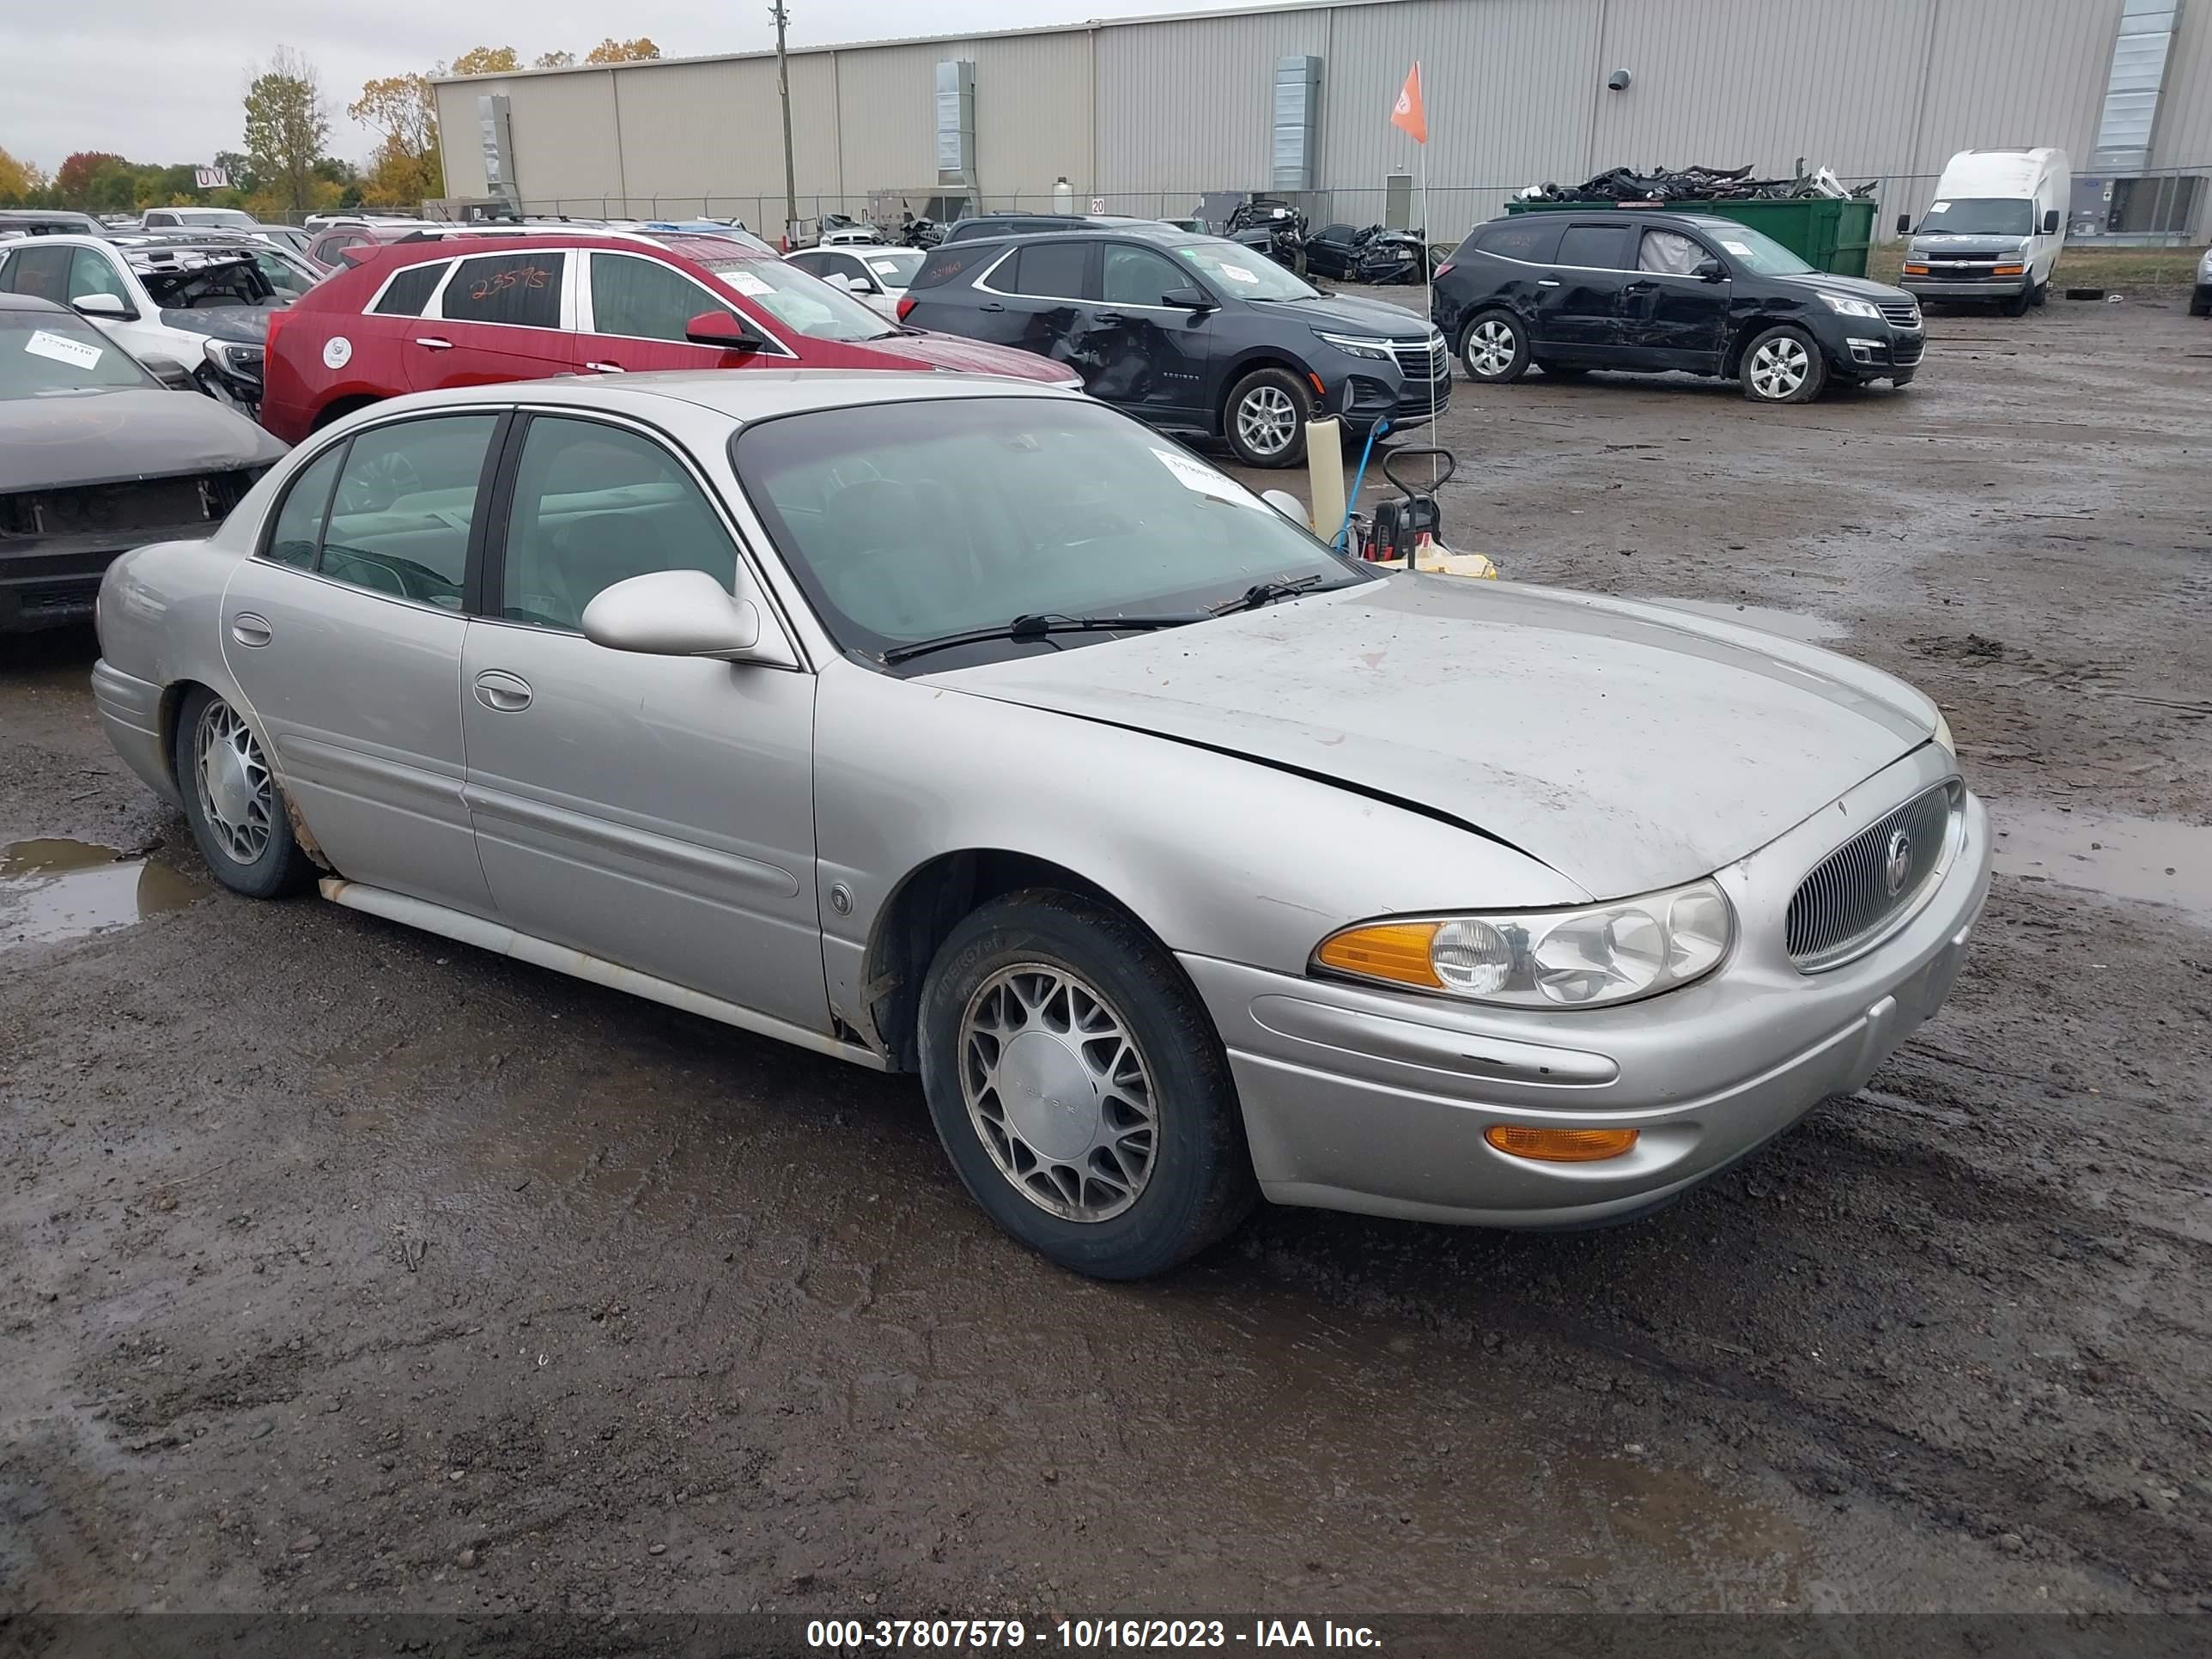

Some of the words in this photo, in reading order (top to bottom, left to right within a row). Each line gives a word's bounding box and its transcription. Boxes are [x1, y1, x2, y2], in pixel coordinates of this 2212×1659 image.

[198, 170, 223, 185] UV
[1093, 200, 1103, 213] 20
[469, 266, 552, 301] 23595
